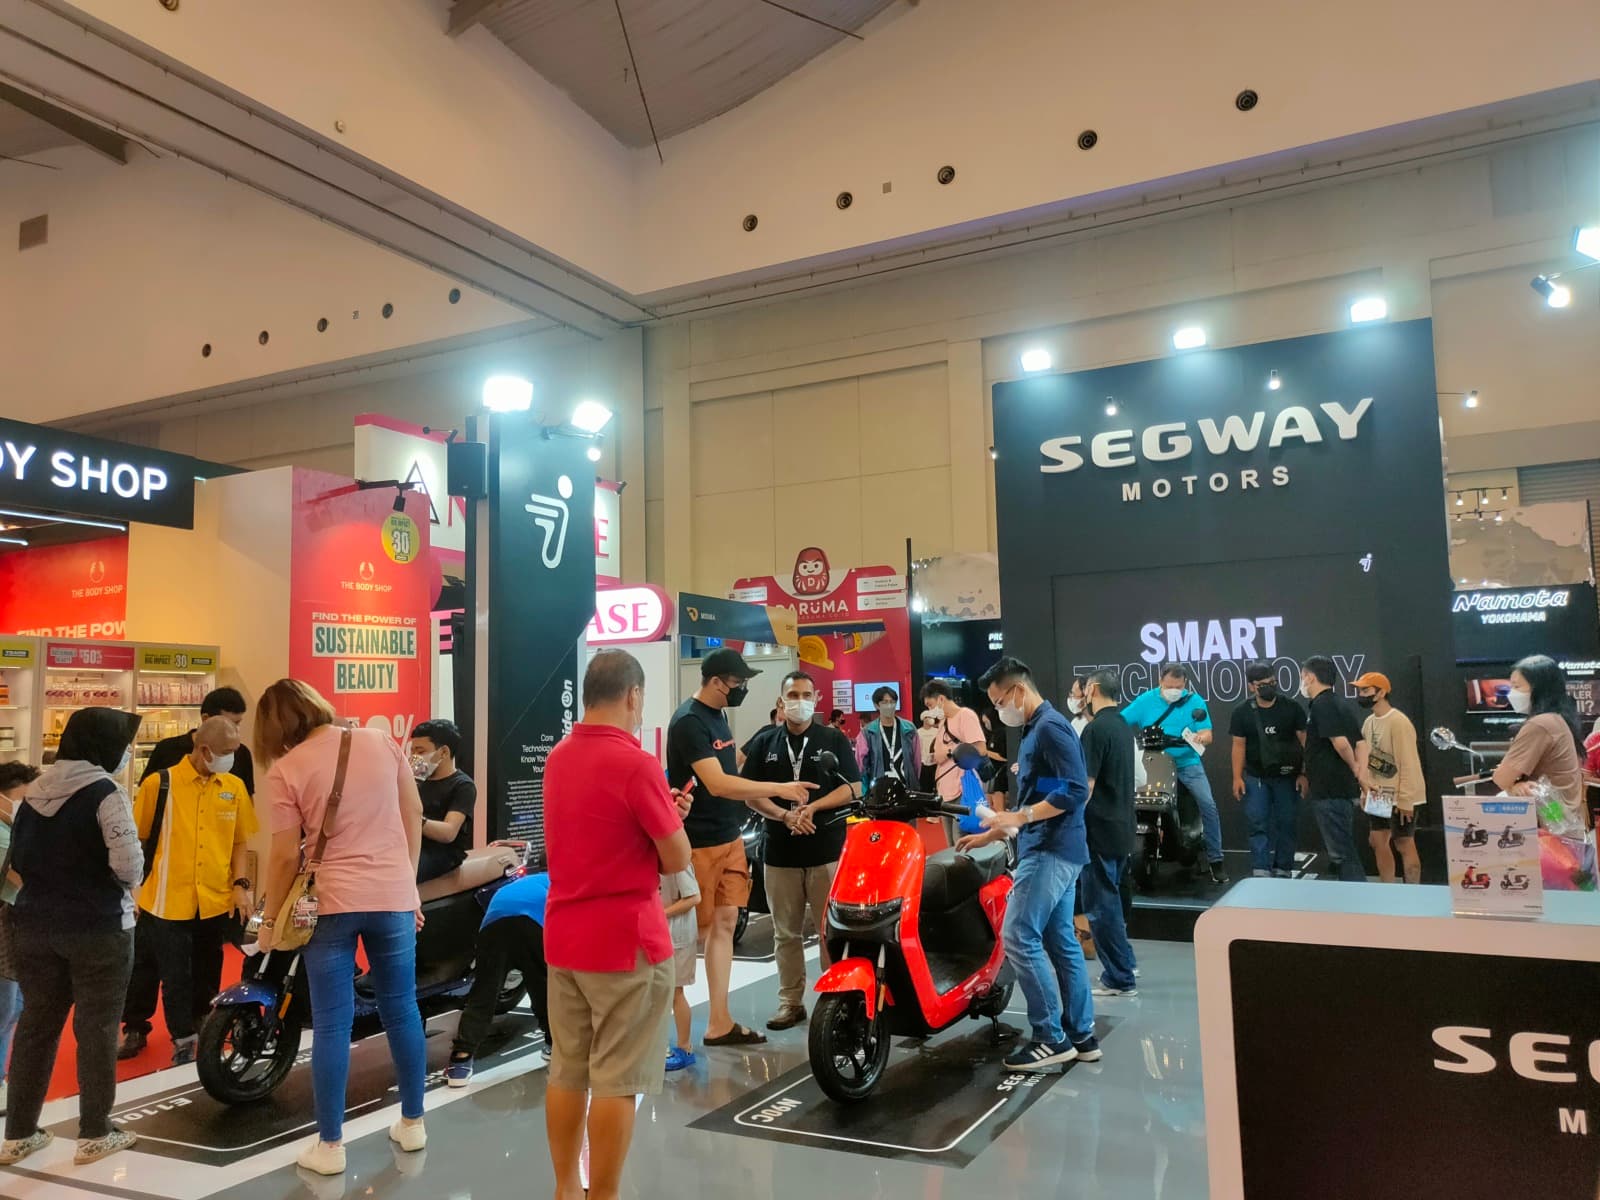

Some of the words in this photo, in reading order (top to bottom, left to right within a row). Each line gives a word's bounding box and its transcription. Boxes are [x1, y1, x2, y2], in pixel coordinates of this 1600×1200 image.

[1040, 397, 1374, 475] SEGWAY
[51, 452, 168, 501] SHOP
[1122, 466, 1291, 502] MOTORS
[392, 530, 410, 554] 30
[72, 588, 85, 598] THE
[85, 586, 103, 597] BODY
[103, 584, 124, 595] SHOP
[341, 581, 355, 590] THE
[355, 582, 374, 592] BODY
[374, 583, 392, 592] SHOP
[312, 612, 339, 621] FIND
[341, 613, 361, 622] THE
[364, 615, 401, 625] POWER
[403, 617, 417, 625] OF
[1481, 612, 1546, 625] YOKOHAMA
[55, 624, 87, 639] THE
[315, 626, 415, 656] SUSTAINABLE
[1139, 616, 1283, 664] SMART
[175, 654, 188, 668] 30
[337, 663, 395, 690] BEAUTY
[750, 1097, 803, 1123] N90C
